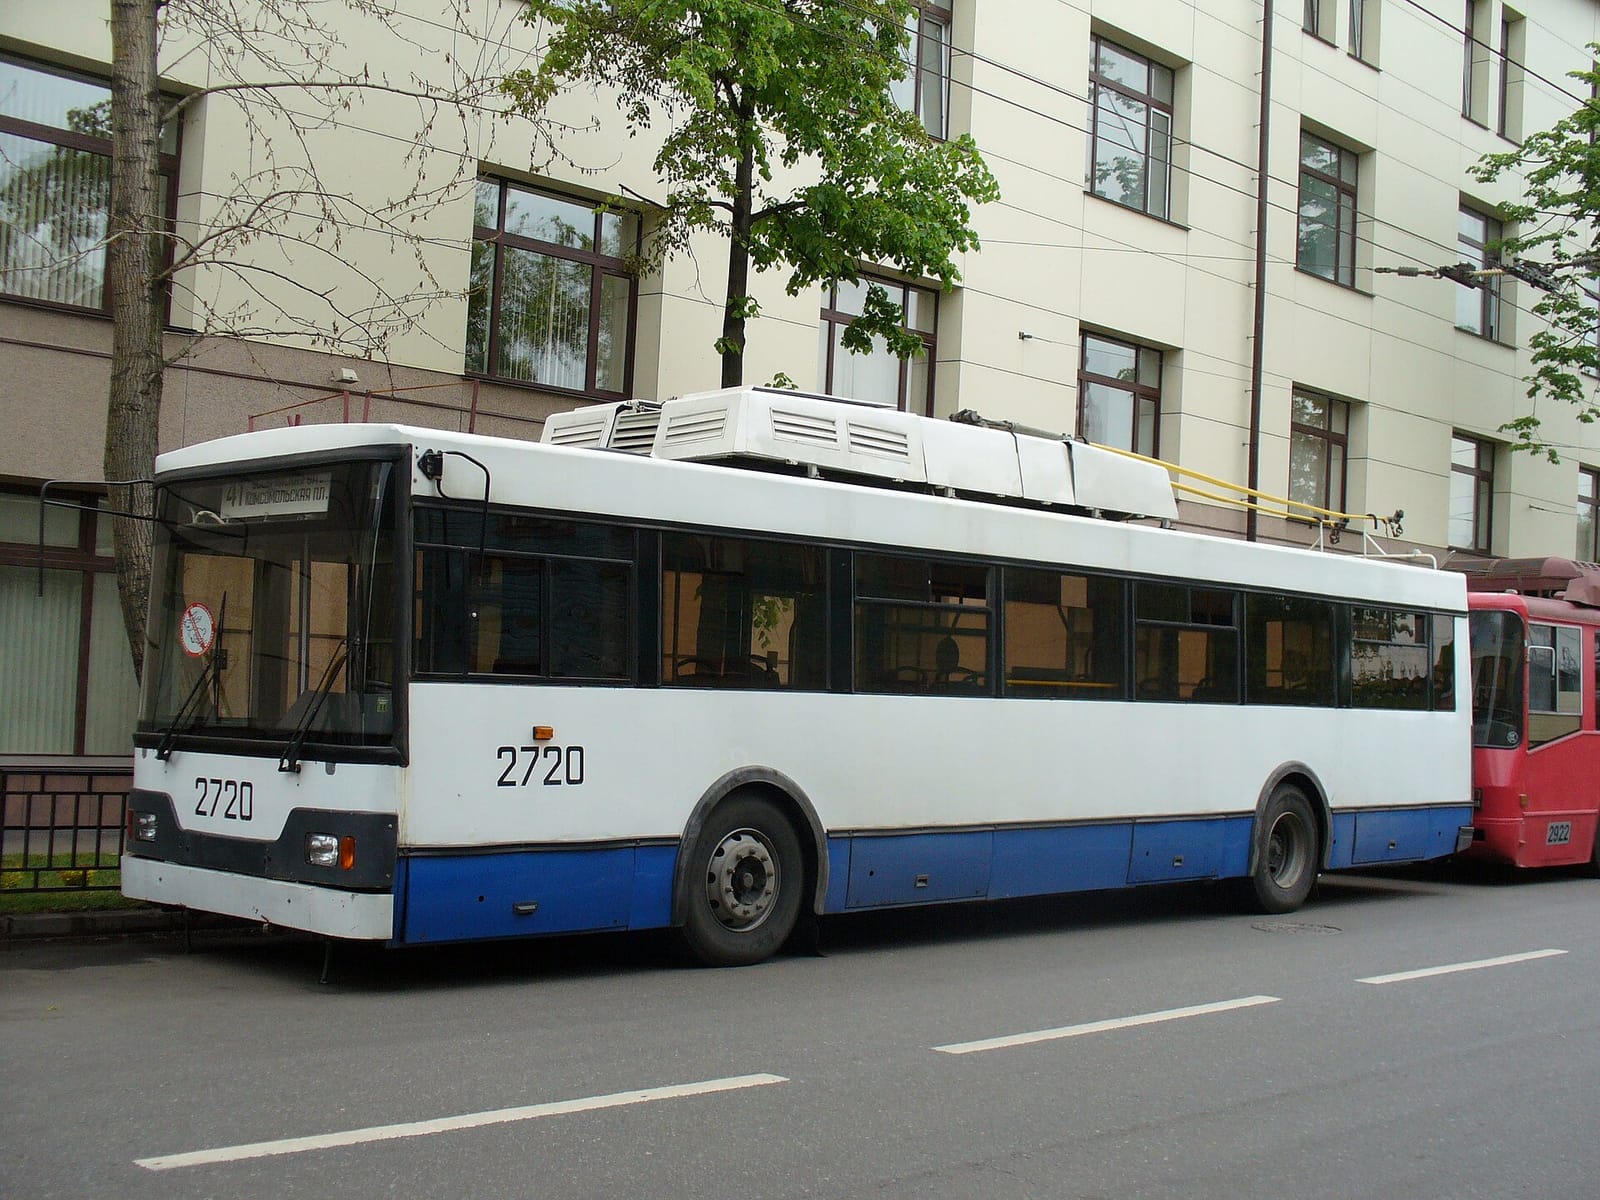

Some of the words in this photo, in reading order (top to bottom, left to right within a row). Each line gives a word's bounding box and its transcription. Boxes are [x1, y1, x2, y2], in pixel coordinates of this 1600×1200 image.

[224, 485, 243, 507] 41
[496, 746, 584, 787] 2720
[195, 777, 253, 821] 2720
[1548, 824, 1569, 842] 2922
